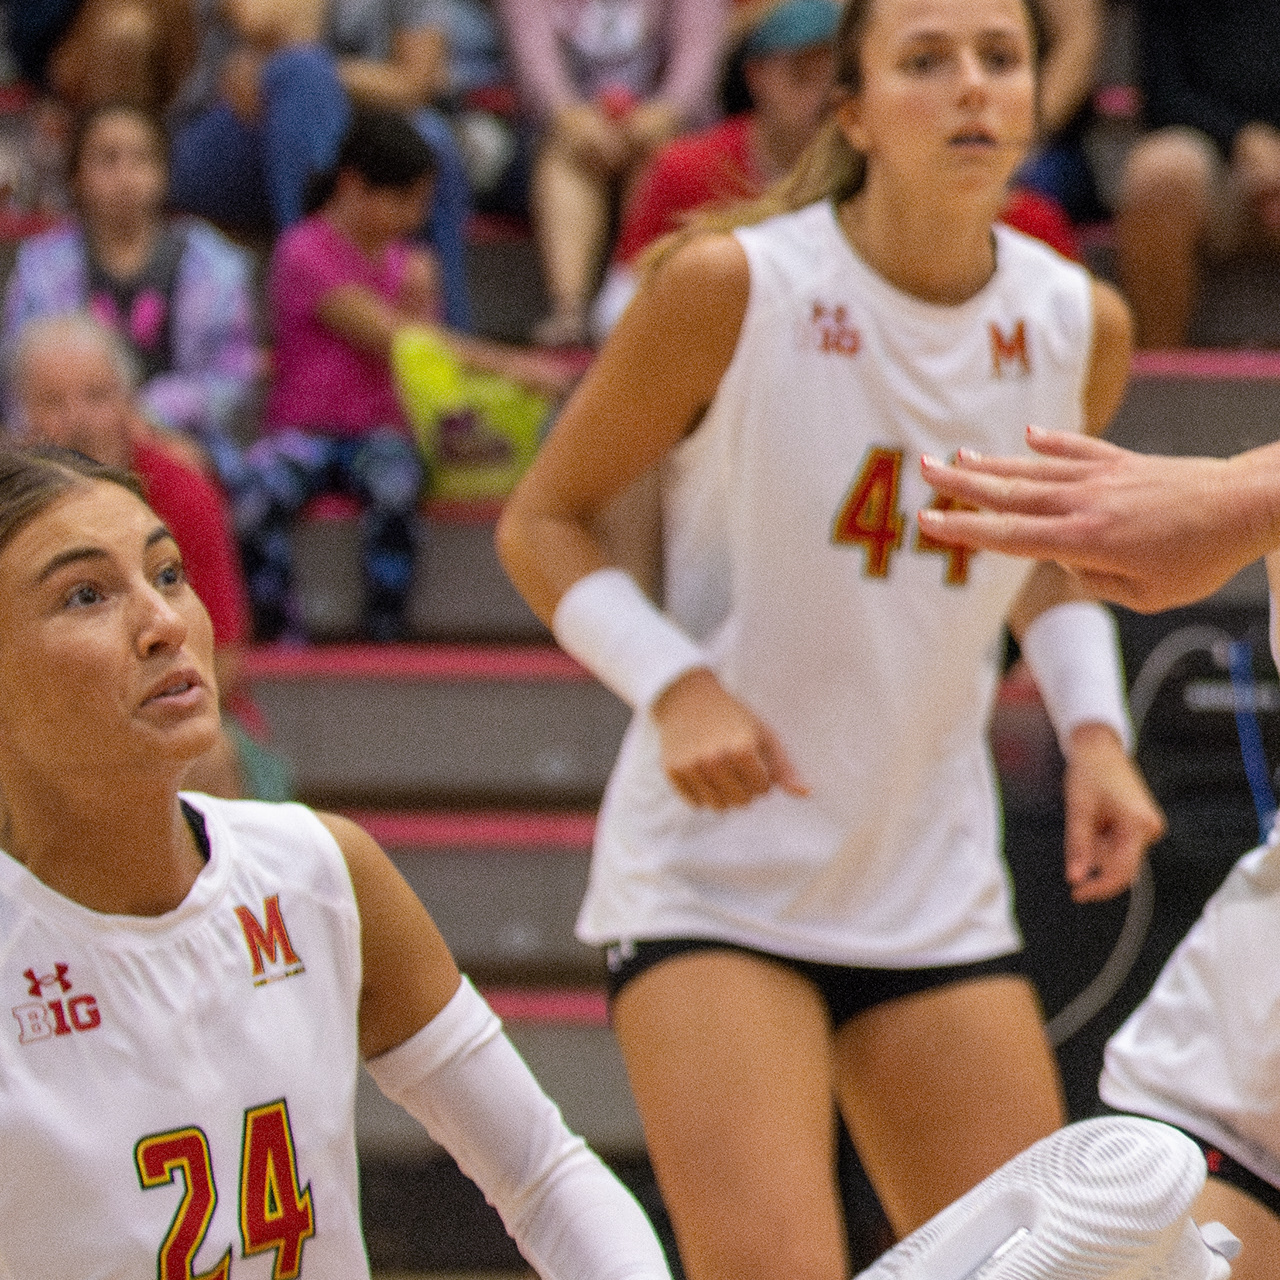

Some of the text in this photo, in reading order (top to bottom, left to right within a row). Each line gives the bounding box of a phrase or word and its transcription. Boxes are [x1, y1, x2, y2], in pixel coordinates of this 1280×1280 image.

[987, 317, 1032, 380] M
[234, 893, 305, 988] M
[133, 1095, 316, 1280] 24
